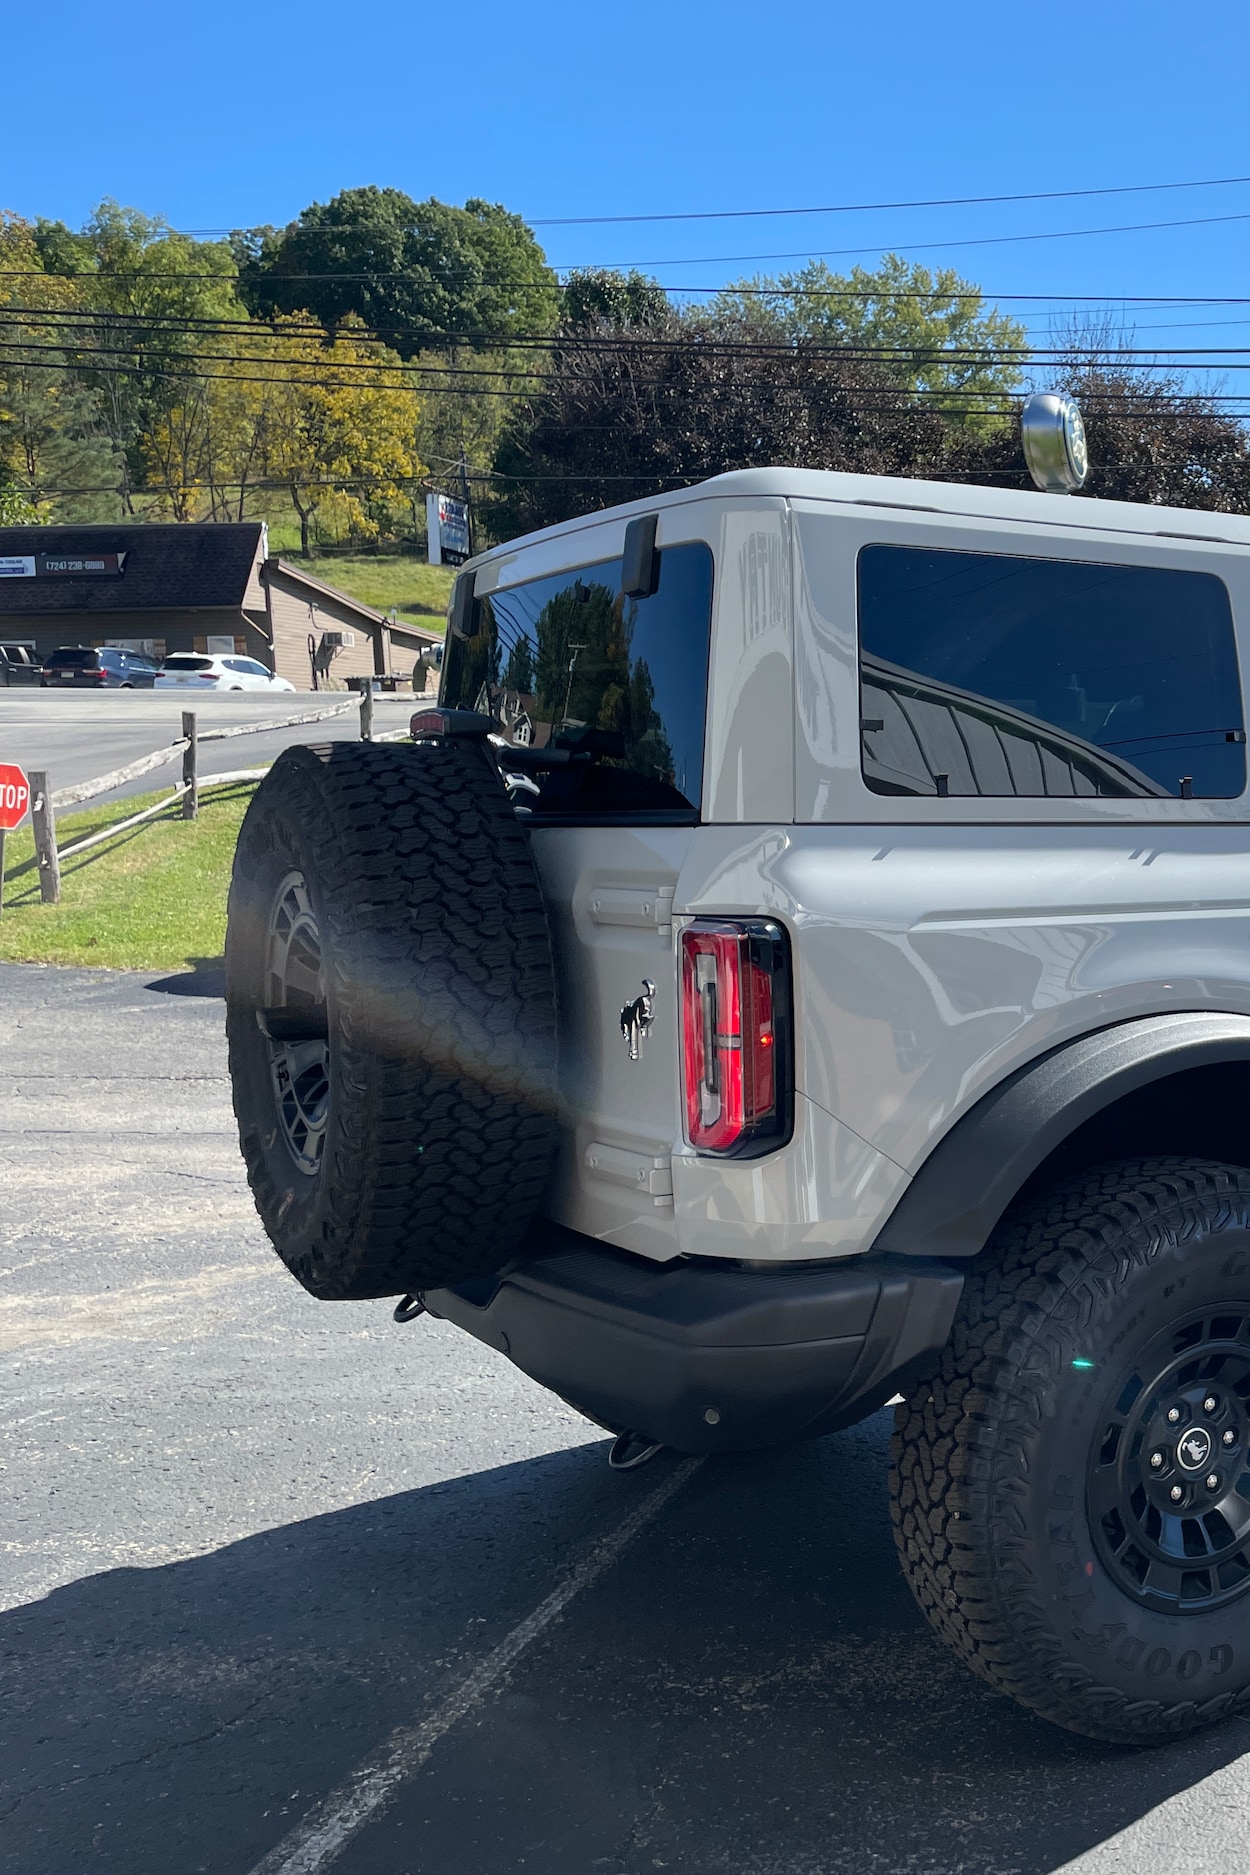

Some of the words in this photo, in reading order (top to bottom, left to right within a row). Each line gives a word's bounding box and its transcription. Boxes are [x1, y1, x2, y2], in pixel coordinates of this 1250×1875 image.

[46, 561, 67, 571] (724)
[0, 784, 28, 810] TOP
[1047, 1473, 1235, 1683] GOODYEAR
